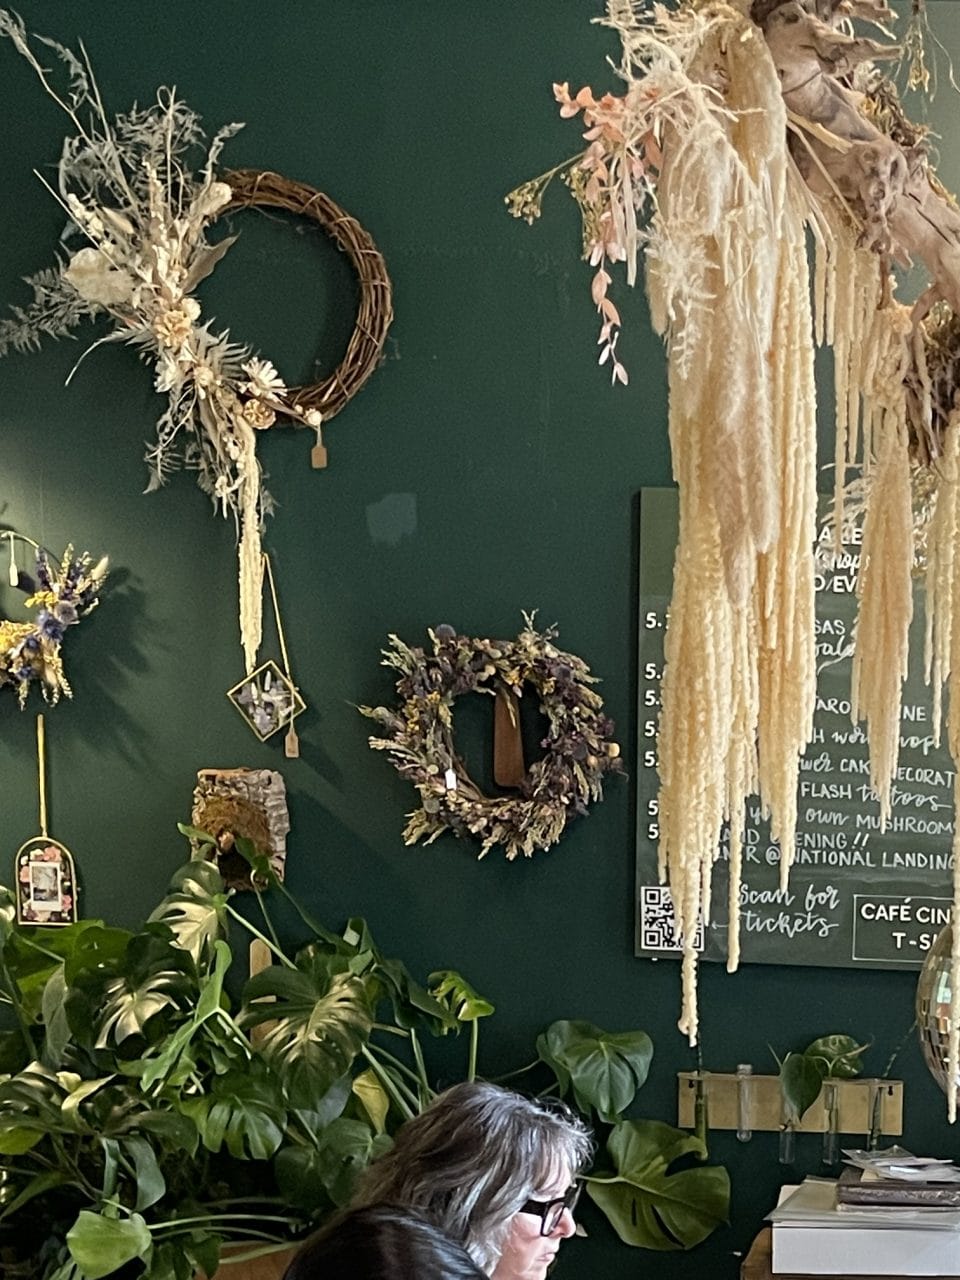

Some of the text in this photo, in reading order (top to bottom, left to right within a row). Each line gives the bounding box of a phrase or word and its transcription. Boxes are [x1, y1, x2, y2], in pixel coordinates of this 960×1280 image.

[645, 663, 661, 679] 5.
[645, 690, 660, 705] 5.
[645, 721, 659, 737] 5.
[645, 751, 659, 766] 5.
[840, 759, 871, 775] CAK
[898, 767, 958, 788] ECORAT
[801, 782, 953, 811] FLASH tatoos
[648, 800, 659, 815] 5
[805, 808, 849, 825] own
[648, 828, 659, 839] 5
[740, 884, 840, 912] Scan for
[740, 909, 840, 937] tickets
[861, 897, 951, 925] CAFÉ CIN
[892, 932, 937, 950] T-S
